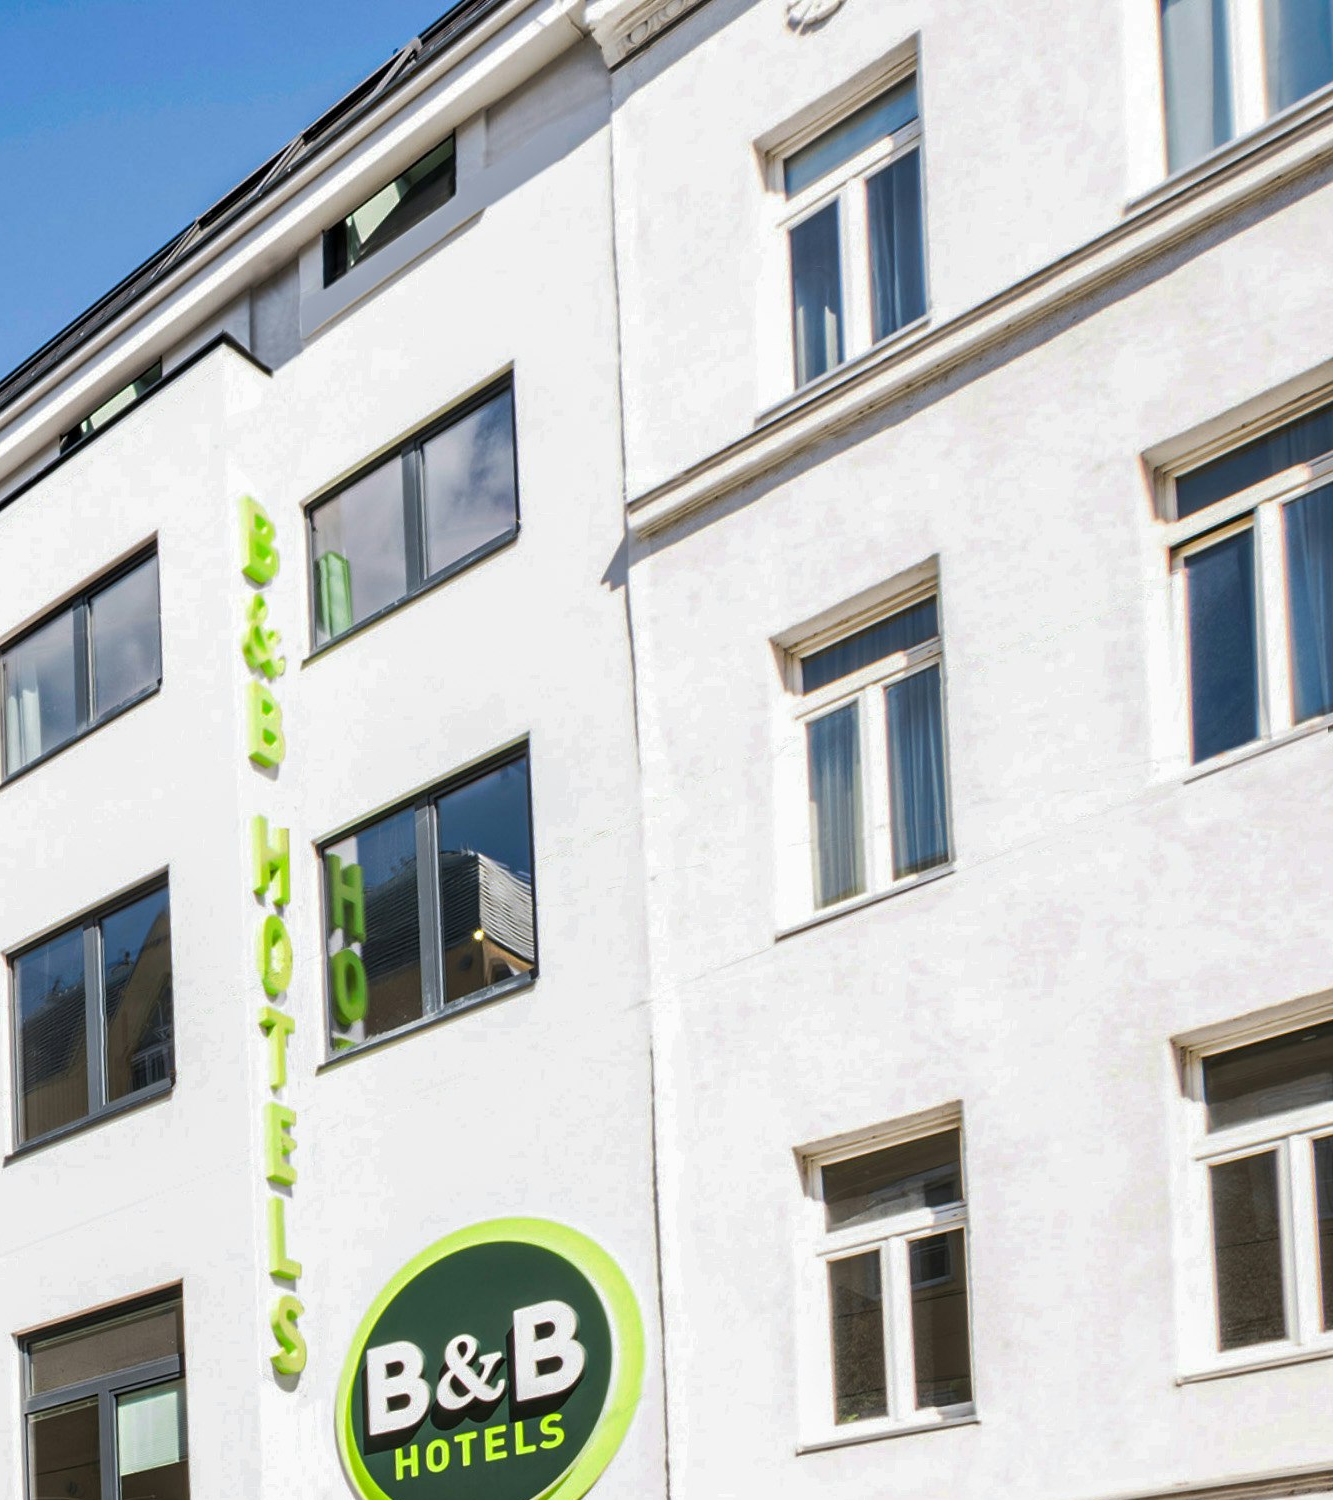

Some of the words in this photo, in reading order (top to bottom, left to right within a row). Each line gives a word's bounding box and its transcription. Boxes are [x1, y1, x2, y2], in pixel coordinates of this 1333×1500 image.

[239, 496, 285, 769] B&B
[251, 815, 307, 1374] HOTELS
[366, 1300, 586, 1436] B&B
[395, 1413, 565, 1481] HOTELS
